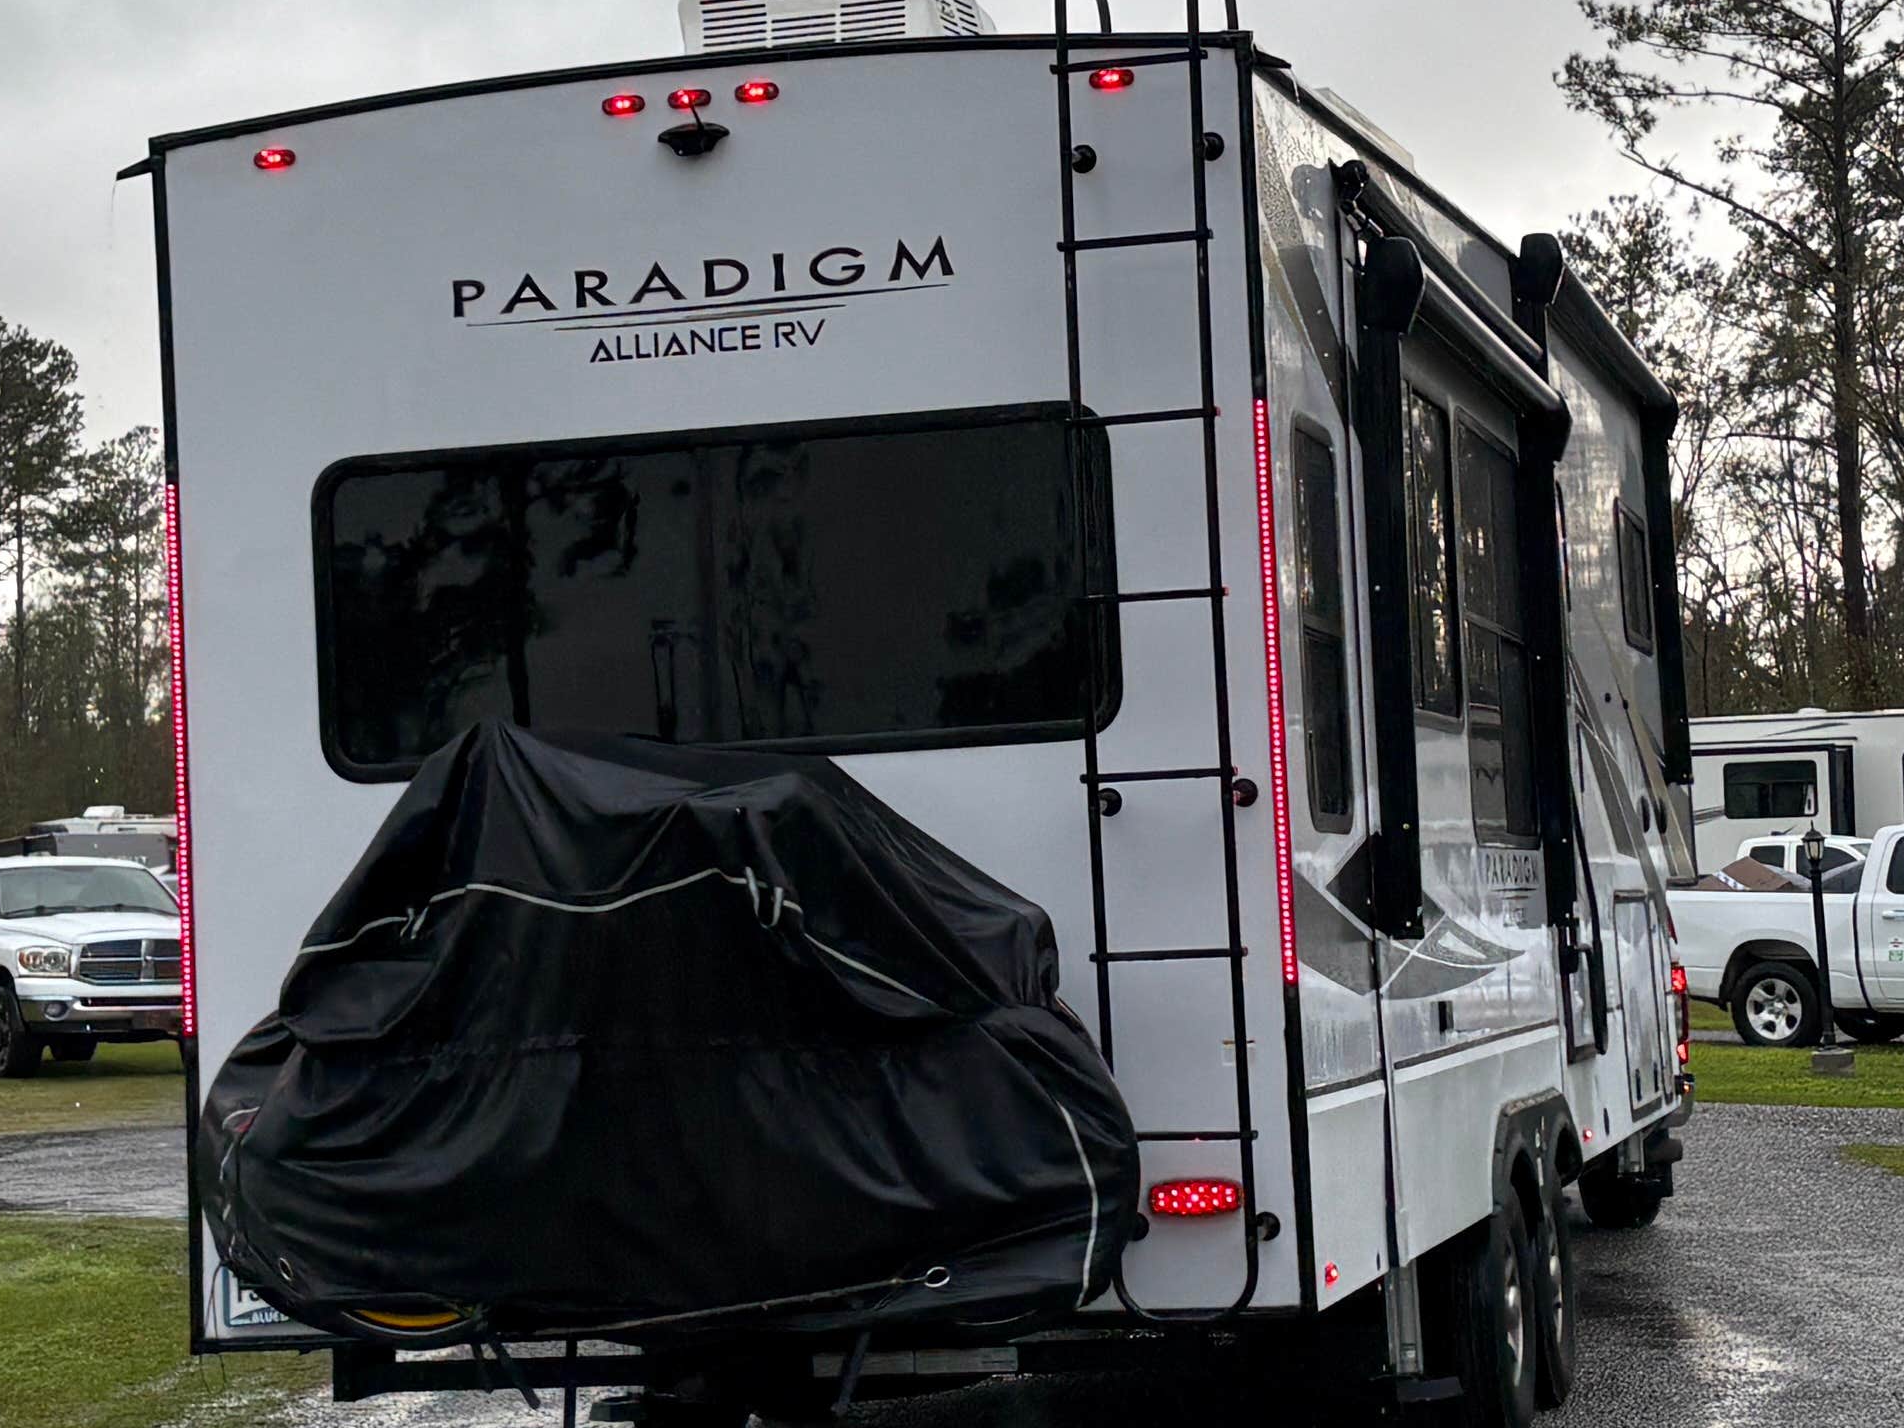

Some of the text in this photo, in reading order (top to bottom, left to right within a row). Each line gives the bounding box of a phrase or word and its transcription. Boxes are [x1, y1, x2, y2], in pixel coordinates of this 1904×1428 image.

[452, 234, 955, 319] PARADIGM
[589, 318, 826, 363] ALLIANCE RV
[1485, 852, 1540, 885] PARADIGM
